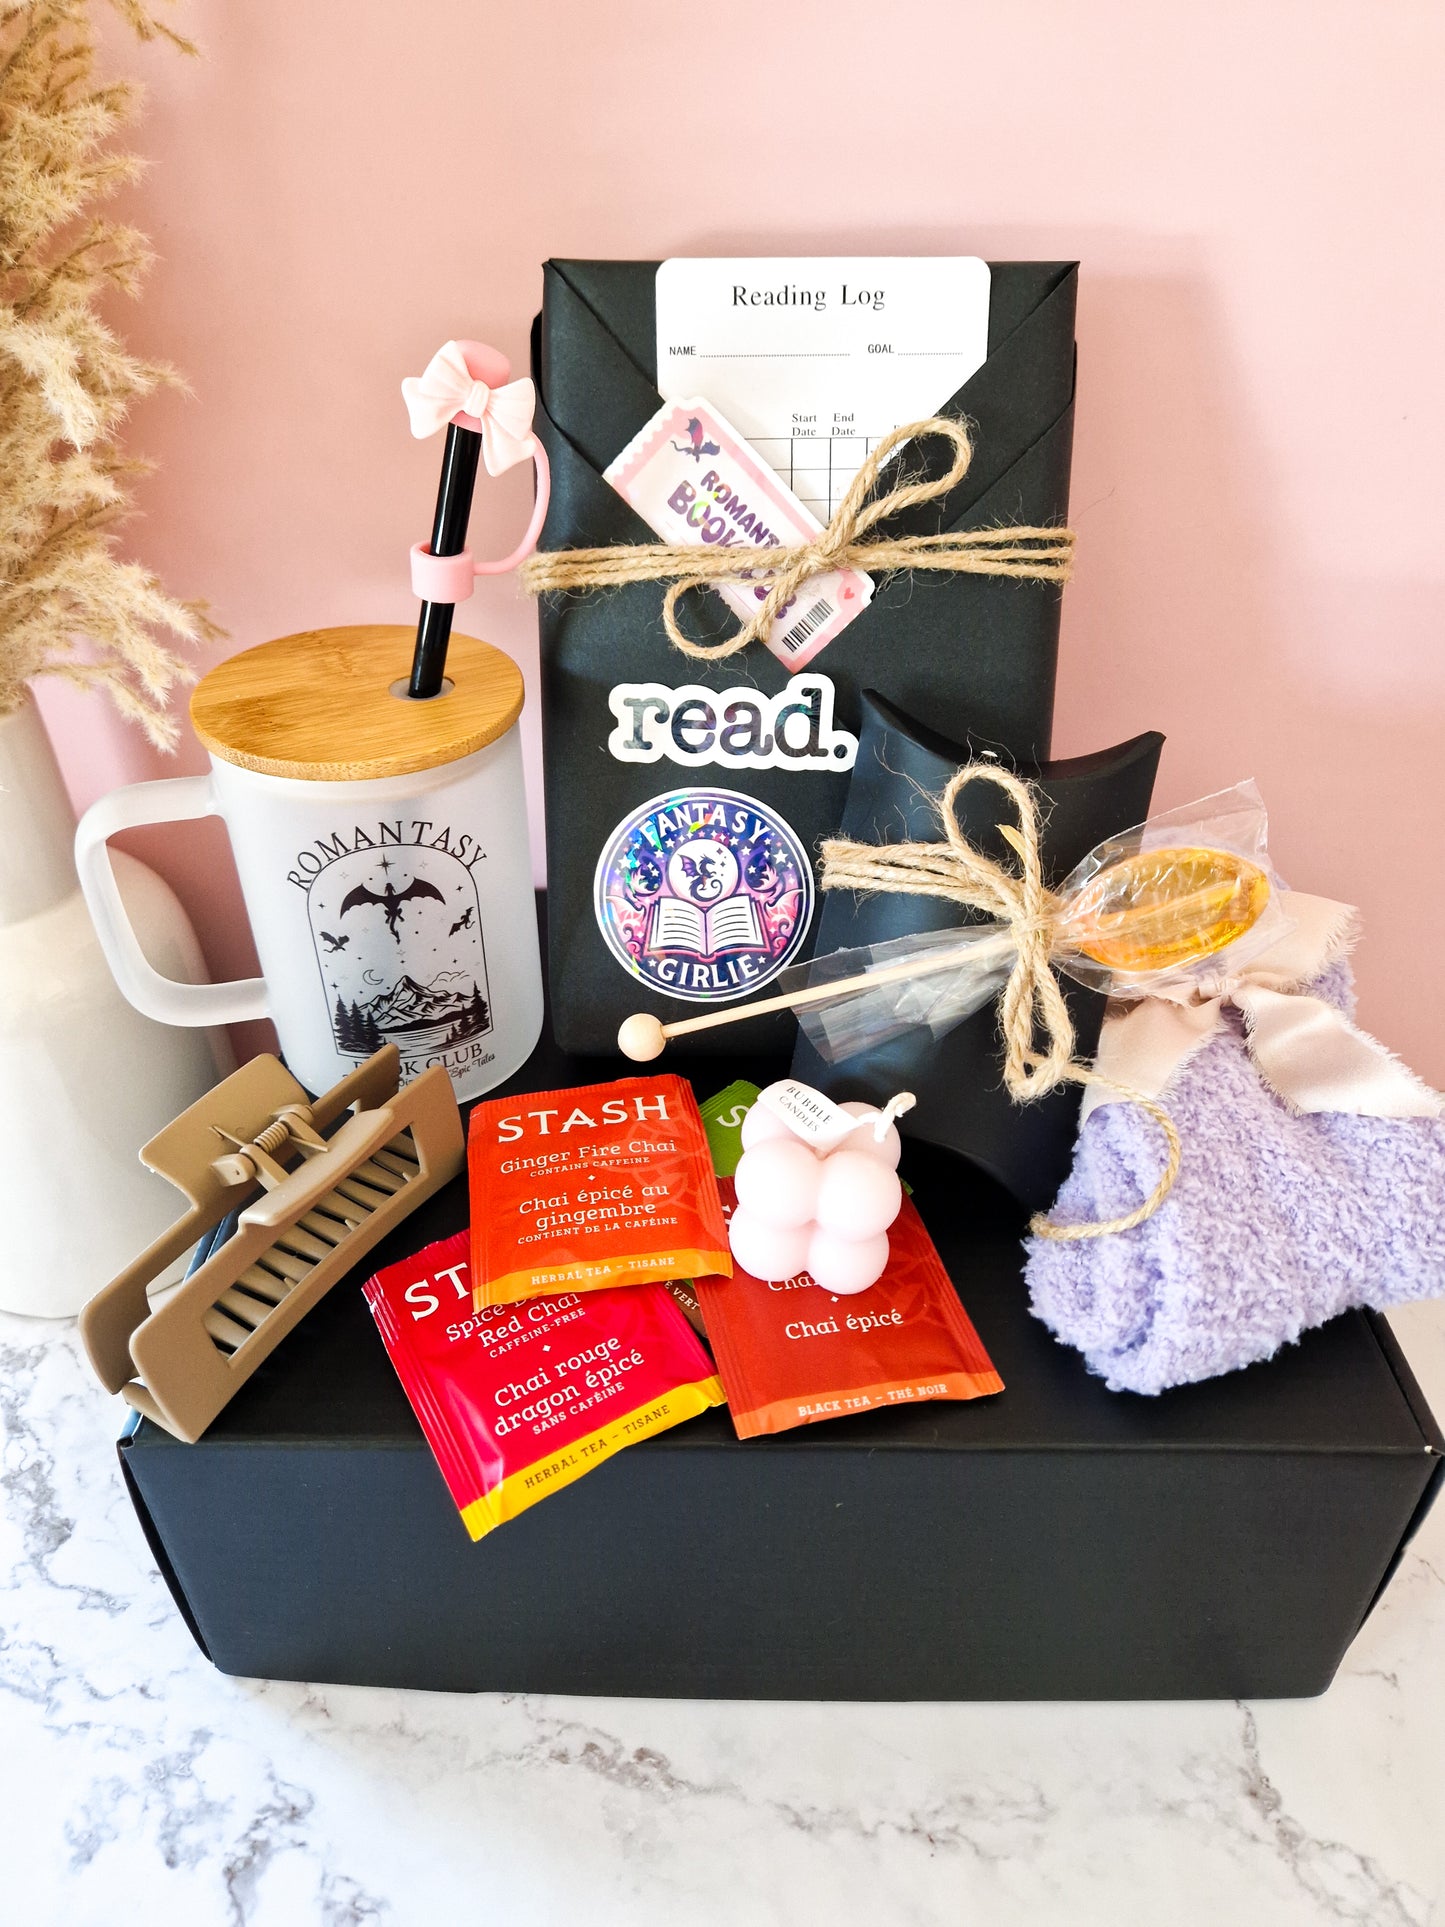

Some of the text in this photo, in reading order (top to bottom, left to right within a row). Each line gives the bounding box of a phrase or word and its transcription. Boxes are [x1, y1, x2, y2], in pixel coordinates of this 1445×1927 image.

[732, 284, 886, 312] Reading Log
[669, 345, 697, 356] NAME
[867, 343, 894, 354] GOAL
[791, 412, 817, 424] Start
[791, 426, 817, 437] Date
[831, 426, 856, 437] Date
[832, 412, 855, 424] End
[622, 687, 848, 759] read.
[640, 803, 772, 845] FANTASY
[287, 820, 487, 893] ROMANTASY
[656, 954, 760, 989] GIRLIE
[497, 1094, 671, 1143] STASH
[779, 1095, 820, 1133] CANDLES
[786, 1086, 834, 1125] BUBBLE
[500, 1140, 677, 1174] Ginger Fire Chai
[530, 1156, 651, 1178] CONTAINS CAFFEINE
[519, 1183, 670, 1215] Chai épicé au
[517, 1216, 678, 1245] CONTIENT DE LA CAFÉINE
[535, 1202, 657, 1232] gingembre
[531, 1270, 583, 1285] HERBAL
[586, 1265, 611, 1277] TEA
[628, 1257, 675, 1270] TISANE
[672, 1287, 700, 1310] VERT
[445, 1303, 506, 1342] Spice
[478, 1318, 524, 1347] Red
[527, 1293, 582, 1322] Chai
[489, 1307, 586, 1359] CAFFEINE-FREE
[785, 1308, 904, 1340] Chai épicé
[494, 1337, 622, 1407] Chai rouge
[494, 1349, 645, 1436] dragon épicé
[532, 1381, 625, 1435] SANS CAFÉINE
[798, 1400, 841, 1417] BLACK
[845, 1395, 871, 1408] TEA
[887, 1387, 914, 1402] THÉ
[918, 1383, 948, 1397] NOIR
[524, 1455, 578, 1489] HERBAL
[580, 1439, 608, 1457] TEA
[622, 1404, 671, 1434] TISANE
